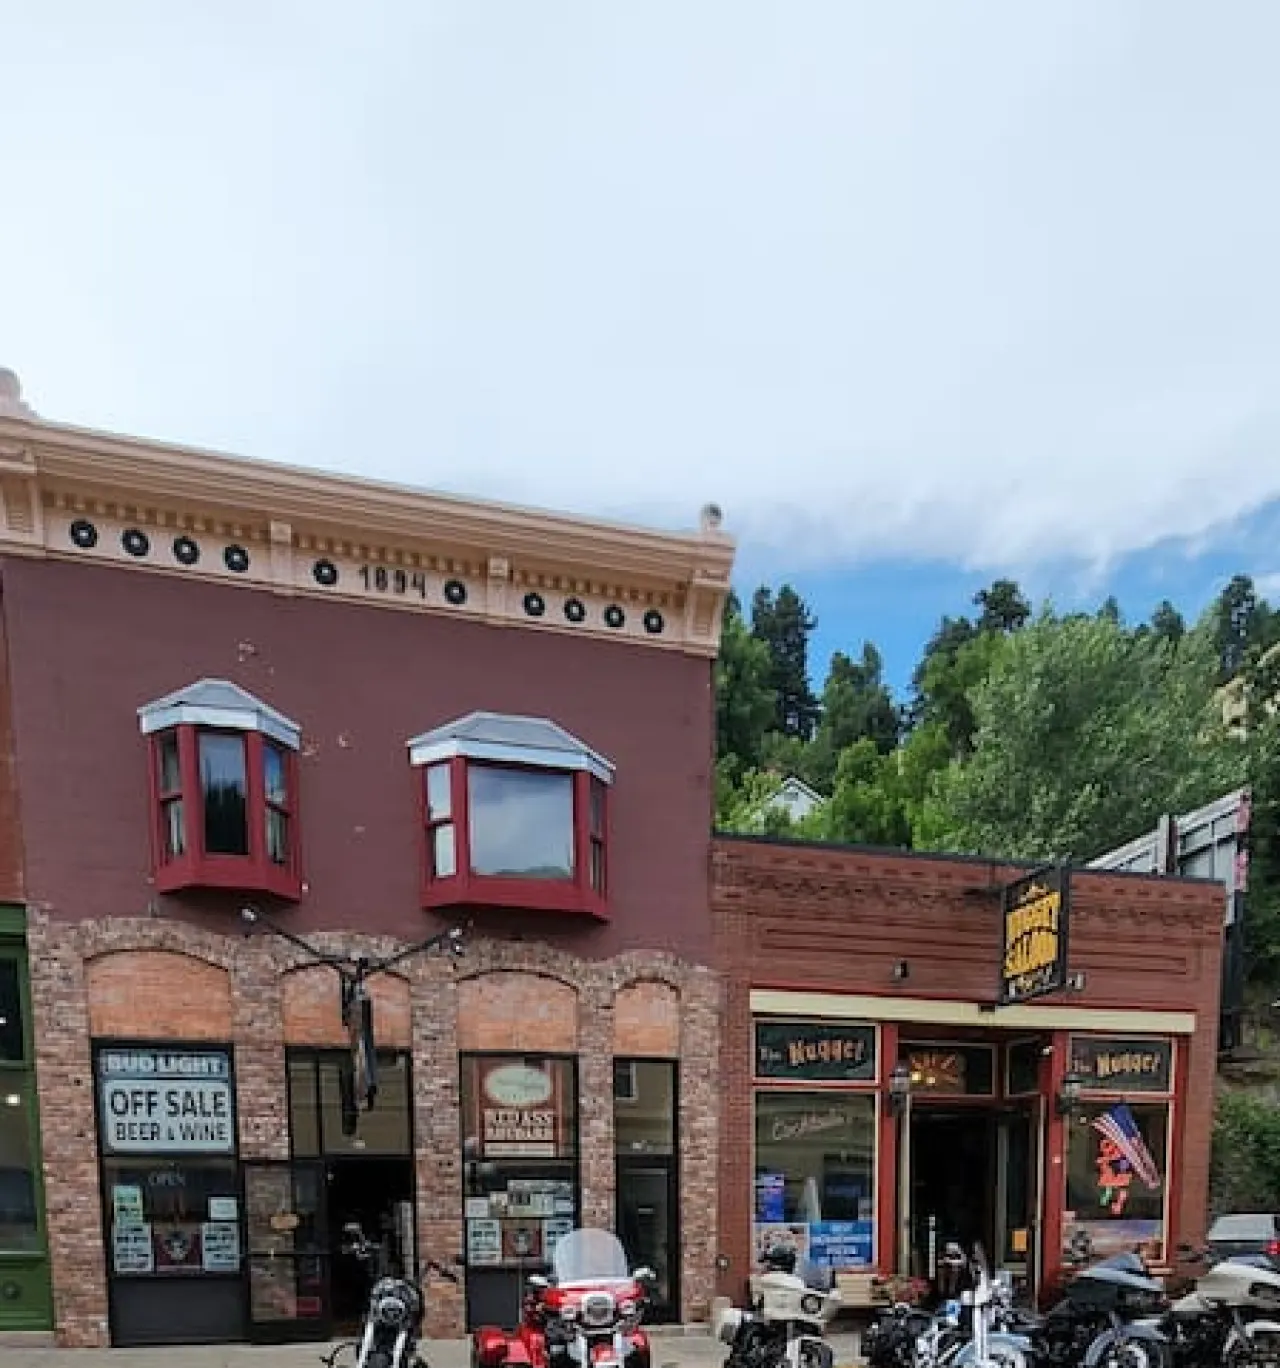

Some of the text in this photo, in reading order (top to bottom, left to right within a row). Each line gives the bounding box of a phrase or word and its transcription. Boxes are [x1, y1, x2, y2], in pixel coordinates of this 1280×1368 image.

[357, 564, 426, 600] 1894
[106, 1052, 223, 1076] BUD LIGHT
[110, 1089, 226, 1117] OFF SALE
[116, 1122, 160, 1141] BEER
[179, 1122, 228, 1141] WINE
